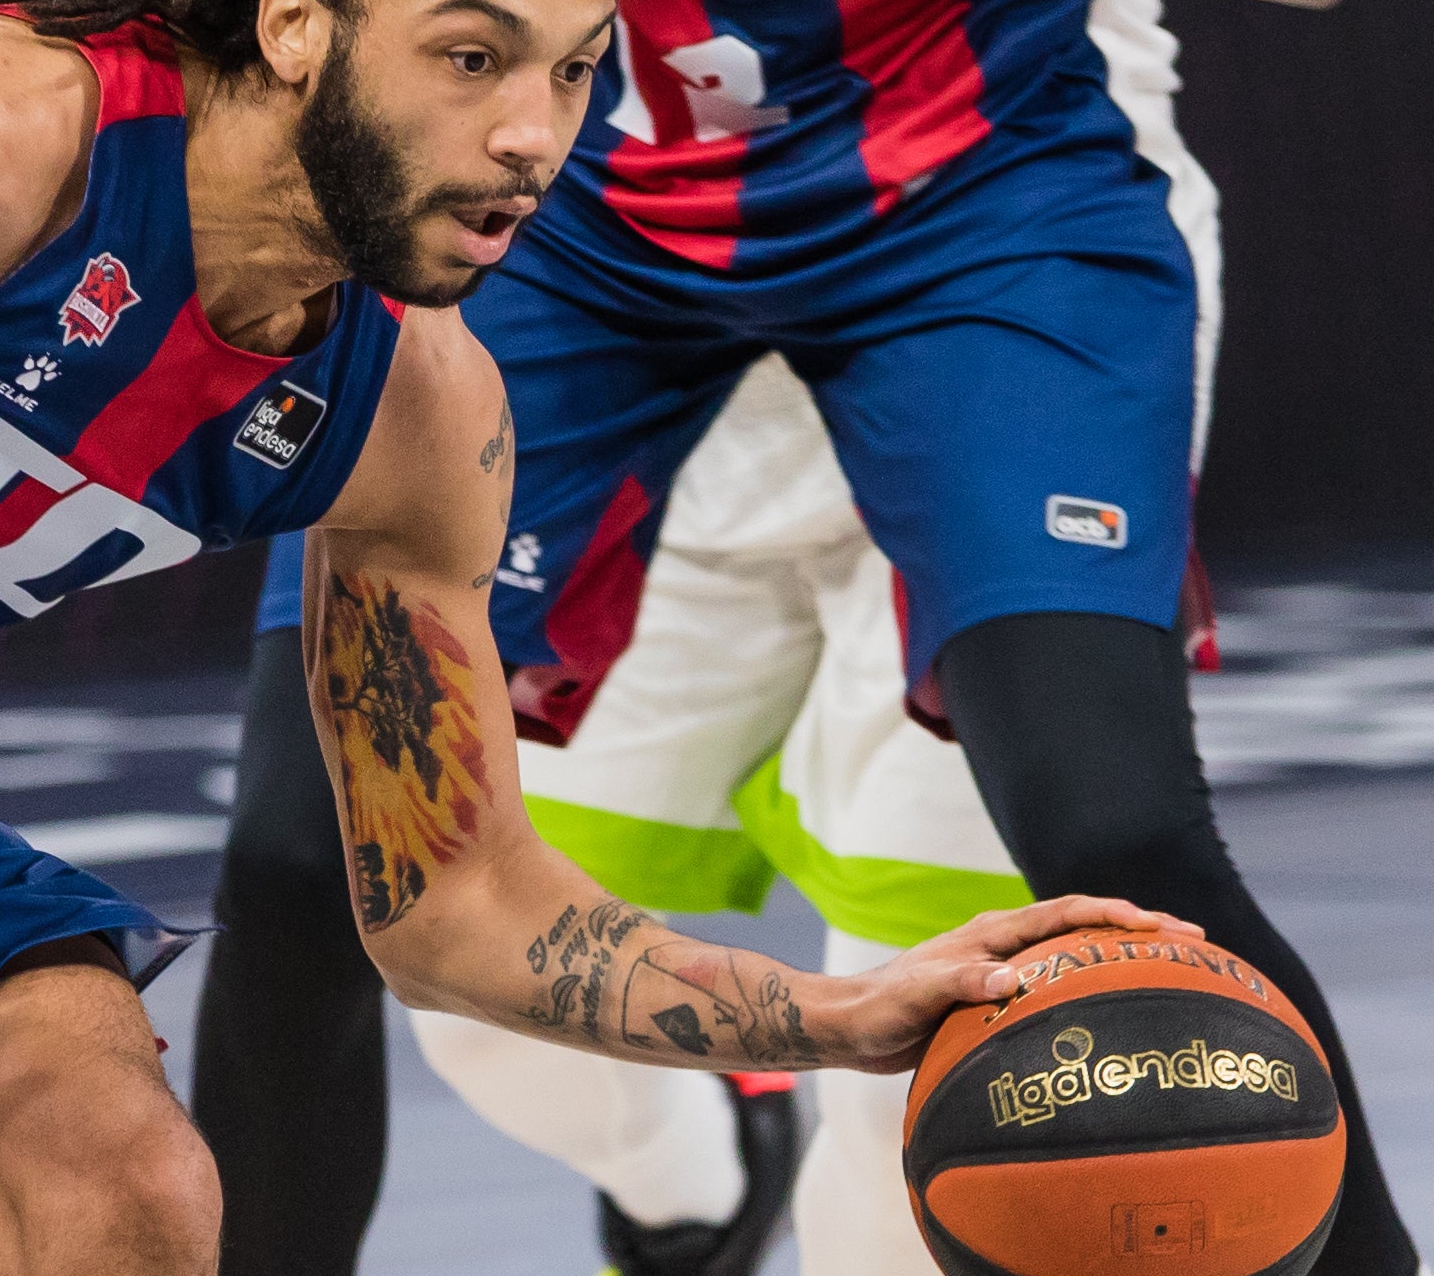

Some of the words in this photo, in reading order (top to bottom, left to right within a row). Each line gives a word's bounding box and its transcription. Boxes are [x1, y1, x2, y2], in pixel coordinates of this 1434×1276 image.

[256, 398, 283, 426] liga
[242, 422, 298, 459] endesa
[988, 1061, 1092, 1126] liga
[1093, 1038, 1299, 1103] endesa
